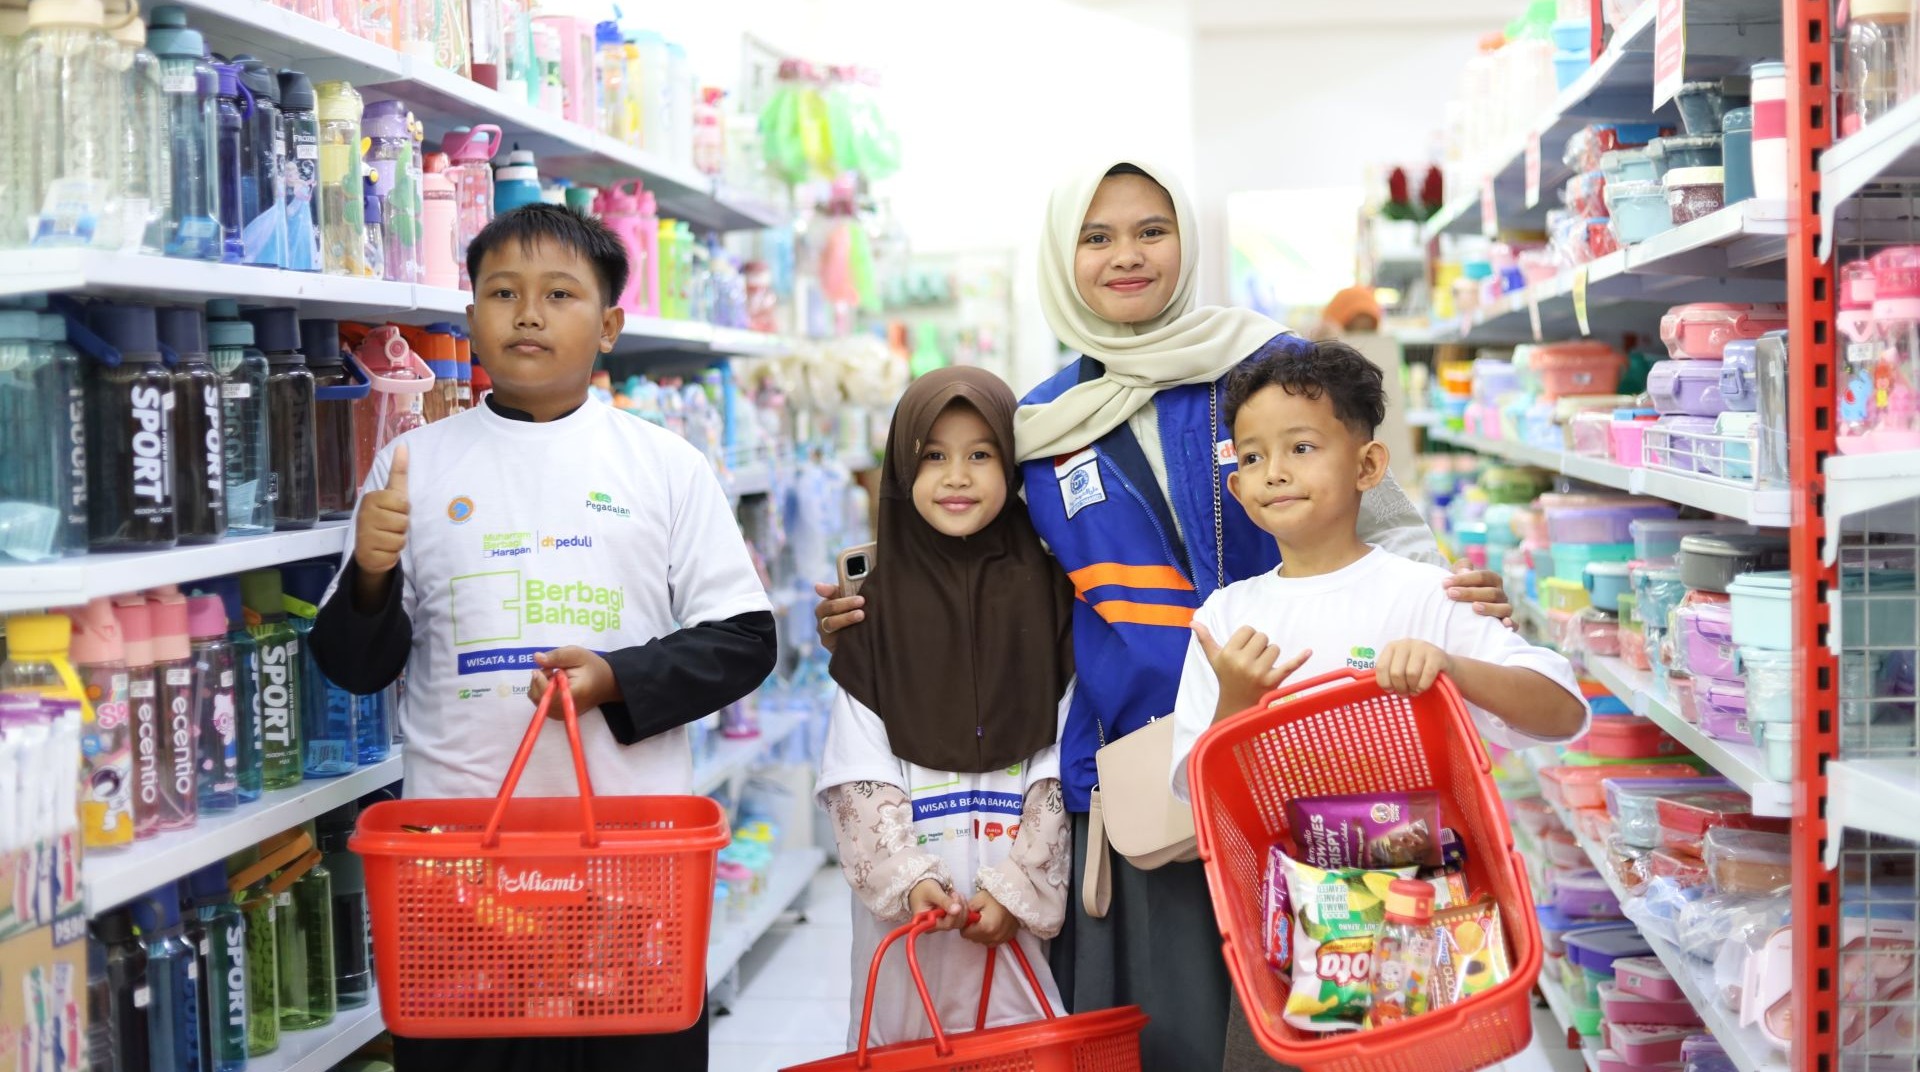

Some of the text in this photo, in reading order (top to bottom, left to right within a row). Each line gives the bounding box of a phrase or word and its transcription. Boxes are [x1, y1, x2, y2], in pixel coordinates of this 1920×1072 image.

[131, 385, 163, 503] SPORT
[204, 385, 222, 496] SPORT
[585, 500, 631, 515] Pegadaian
[492, 546, 532, 557] Harapan
[525, 579, 625, 613] Berbagi
[525, 603, 622, 633] Bahagia
[466, 655, 505, 668] WISATA
[507, 655, 516, 664] &
[1346, 658, 1377, 669] Pegad
[261, 644, 290, 747] SPORT
[137, 703, 158, 804] ecentio
[171, 695, 194, 794] ecentio
[949, 800, 957, 808] &
[505, 870, 585, 893] Miami
[225, 925, 246, 1031] SPORT
